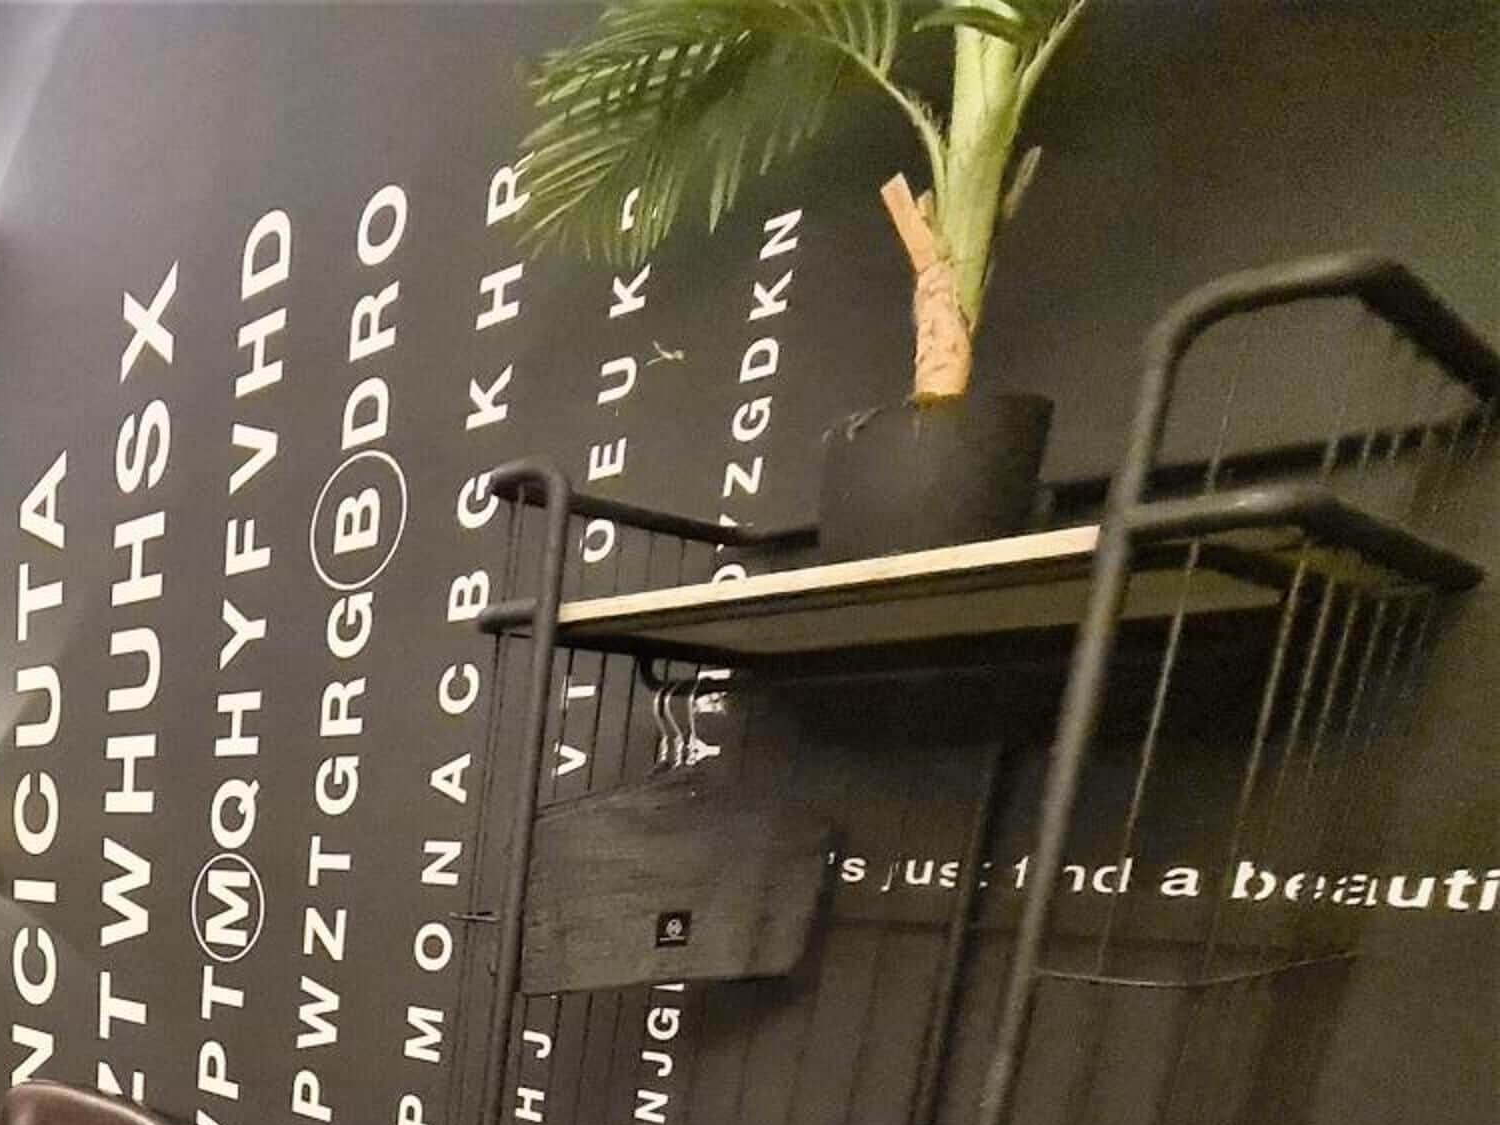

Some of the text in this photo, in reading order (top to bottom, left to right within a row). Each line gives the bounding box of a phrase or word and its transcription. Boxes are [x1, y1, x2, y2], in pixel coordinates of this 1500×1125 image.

[881, 855, 994, 891] jus
[1014, 856, 1133, 892] fnd
[1160, 867, 1199, 897] a
